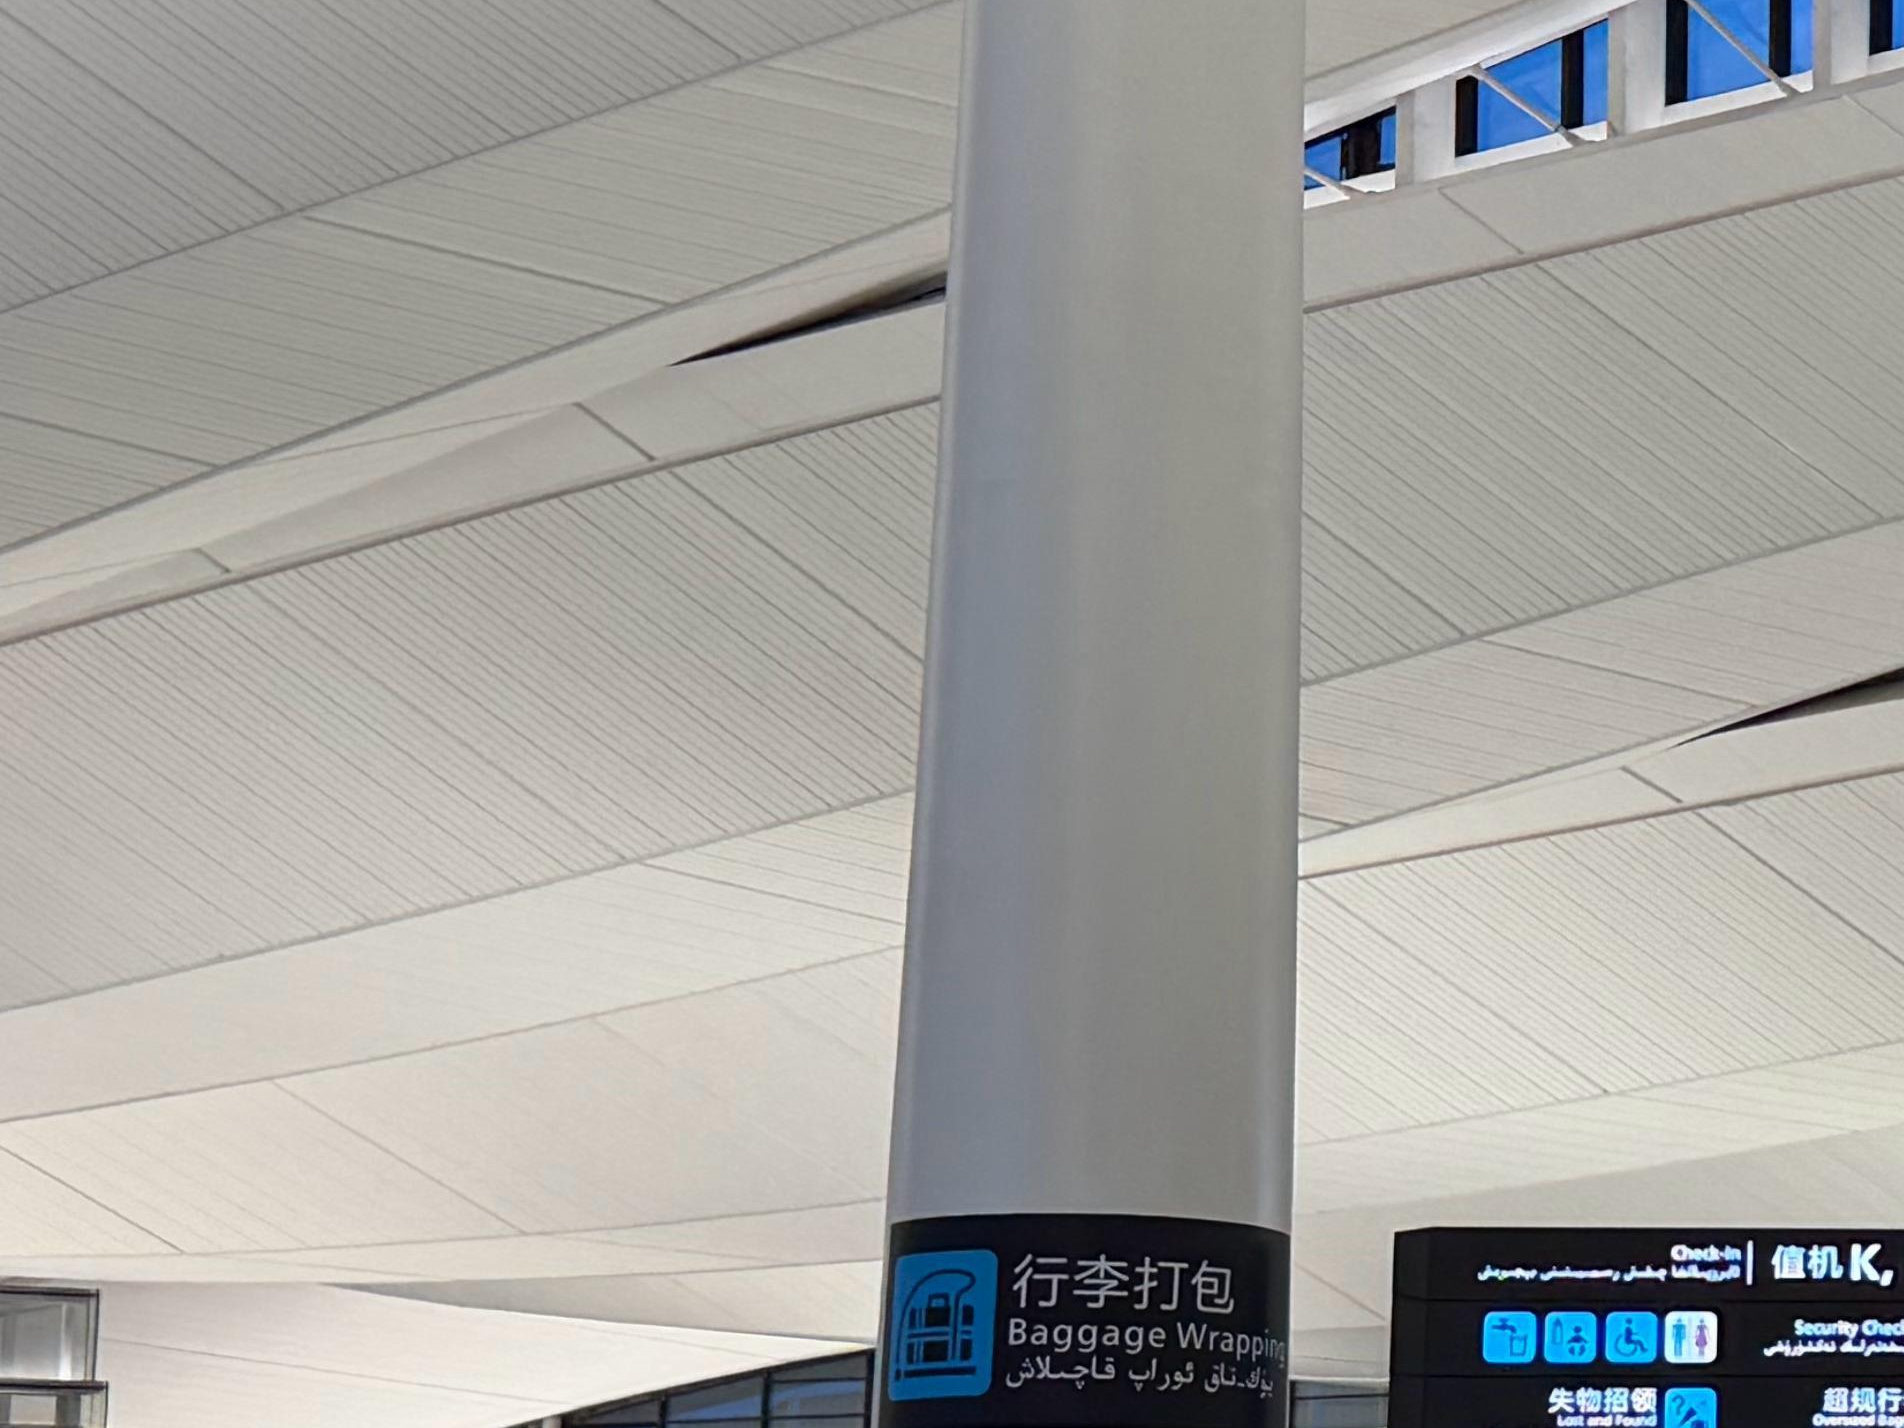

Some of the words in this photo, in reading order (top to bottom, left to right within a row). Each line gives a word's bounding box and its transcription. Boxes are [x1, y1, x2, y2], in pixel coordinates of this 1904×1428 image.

[1671, 1244, 1742, 1262] Check-in
[1771, 1244, 1844, 1279] 值机
[1851, 1243, 1894, 1286] K,
[1012, 1253, 1235, 1314] 行李打包
[1008, 1318, 1167, 1355] Baggage
[1794, 1318, 1859, 1340] Security
[1548, 1387, 1658, 1413] 失物招领
[1556, 1413, 1585, 1427] Lost
[1586, 1413, 1613, 1427] and
[1615, 1413, 1658, 1427] Found
